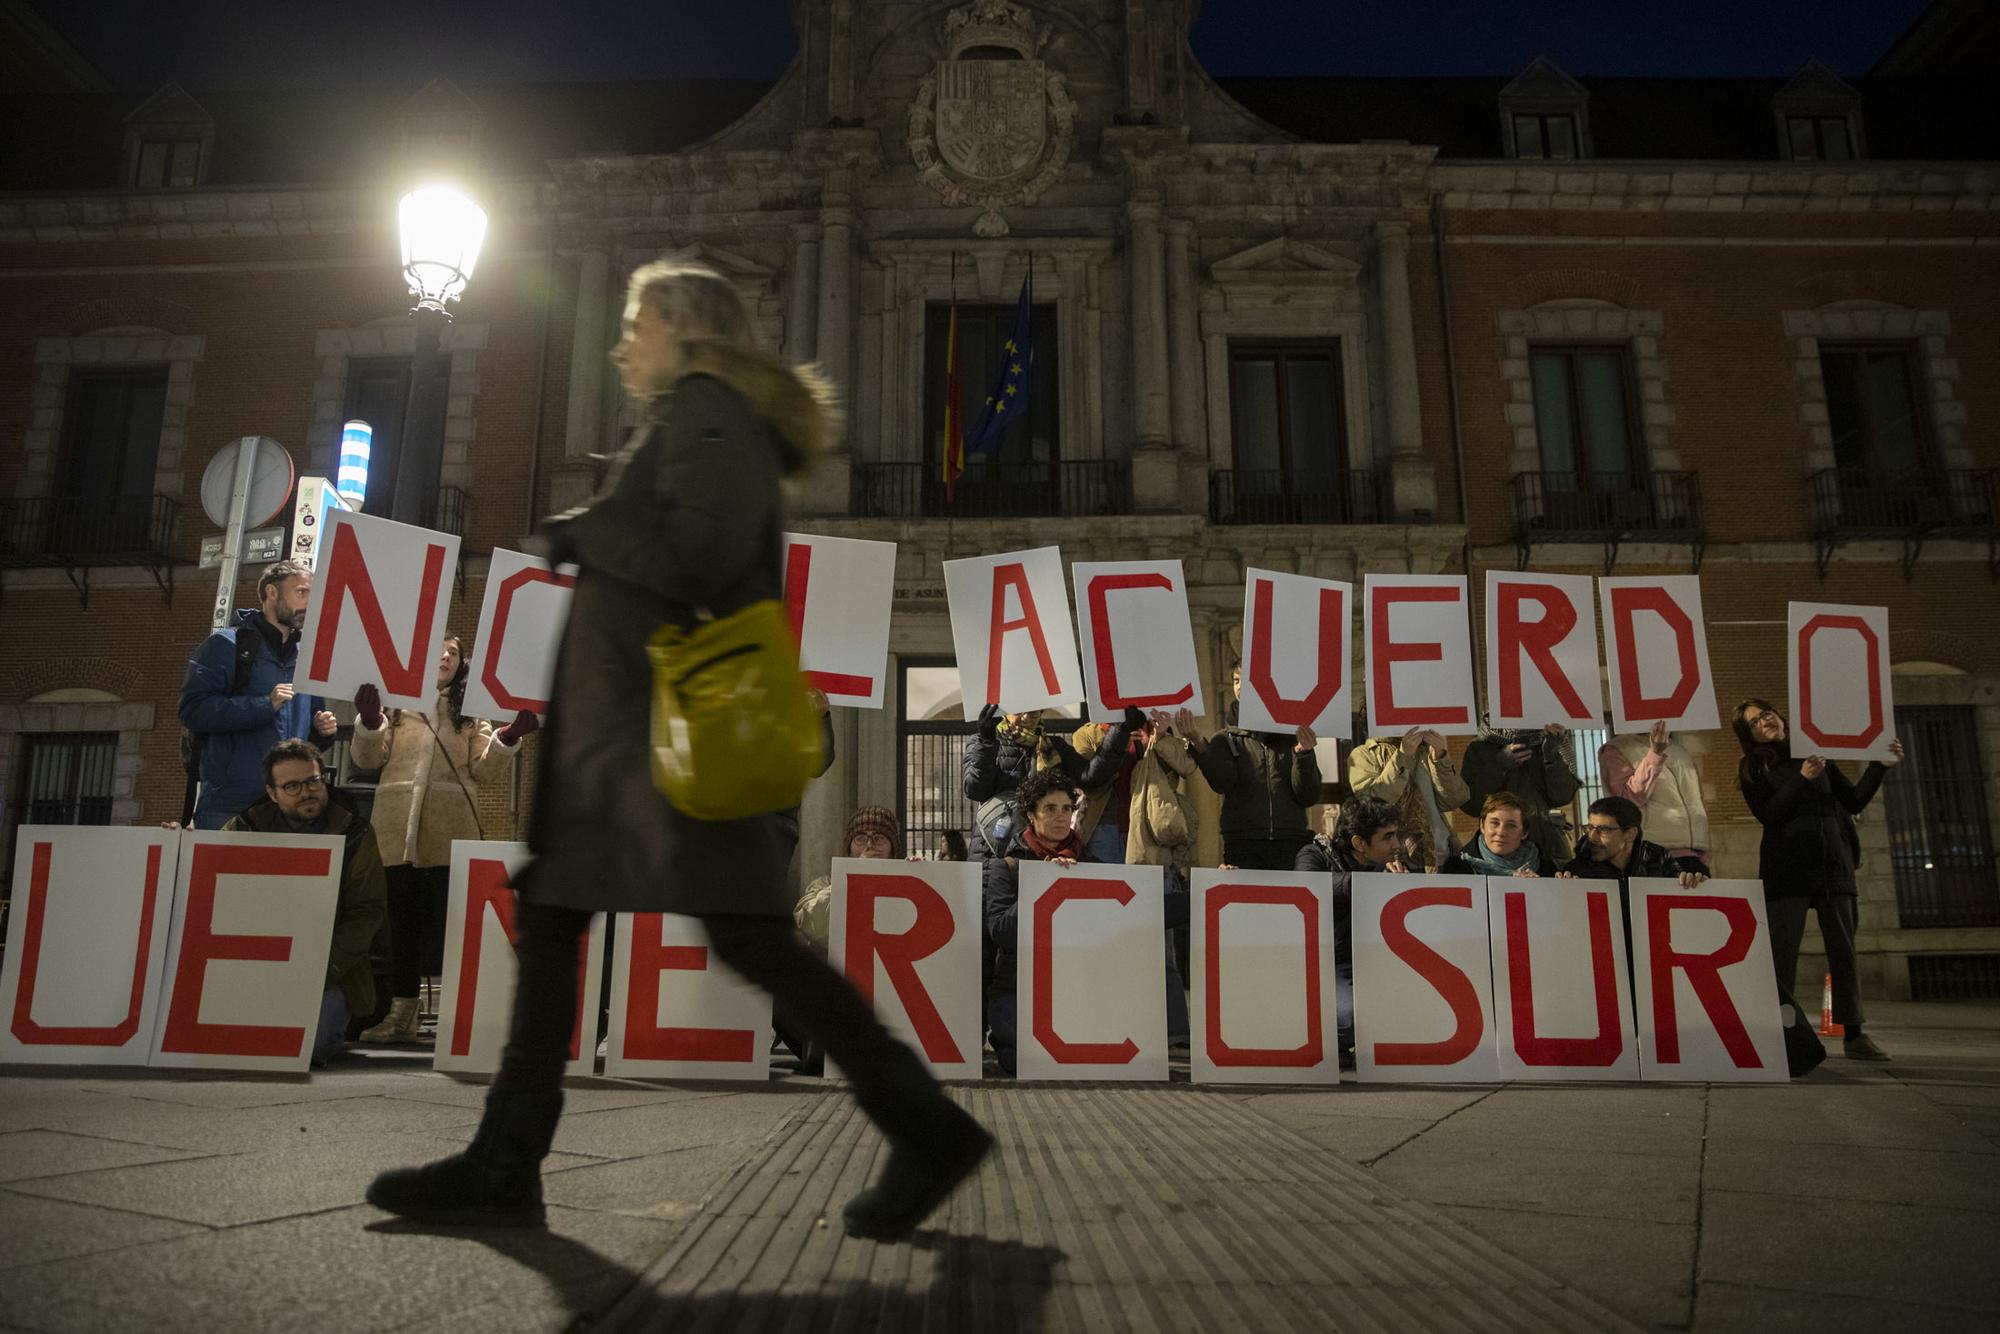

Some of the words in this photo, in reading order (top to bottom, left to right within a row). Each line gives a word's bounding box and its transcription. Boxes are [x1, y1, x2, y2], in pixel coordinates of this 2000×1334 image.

[895, 589, 910, 599] DE
[916, 589, 947, 598] ASUN
[986, 562, 1884, 750] ACUERDO
[11, 842, 332, 1057] UE
